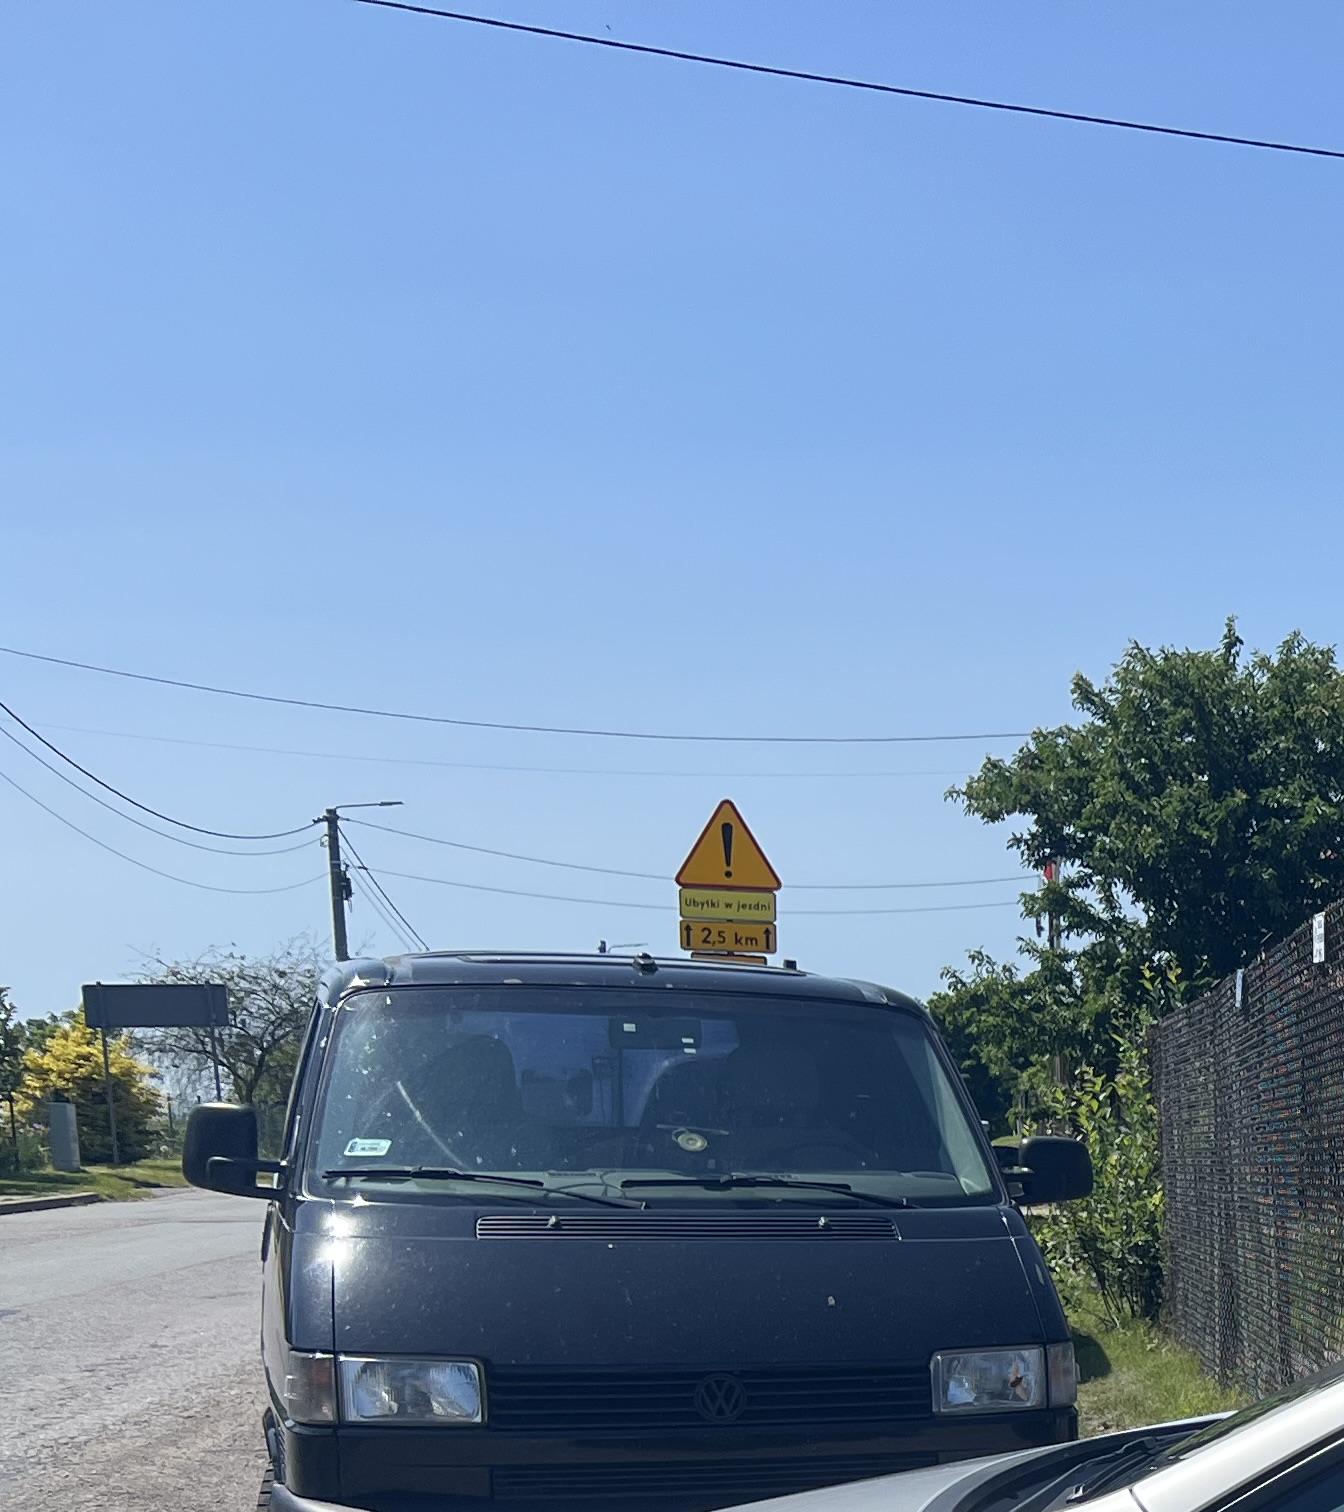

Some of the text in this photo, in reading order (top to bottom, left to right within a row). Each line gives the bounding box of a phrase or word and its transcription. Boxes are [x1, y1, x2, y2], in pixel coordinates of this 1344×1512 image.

[684, 898, 720, 910] Ubytki
[737, 901, 771, 912] jezdni
[701, 927, 758, 946] 2,5 km
